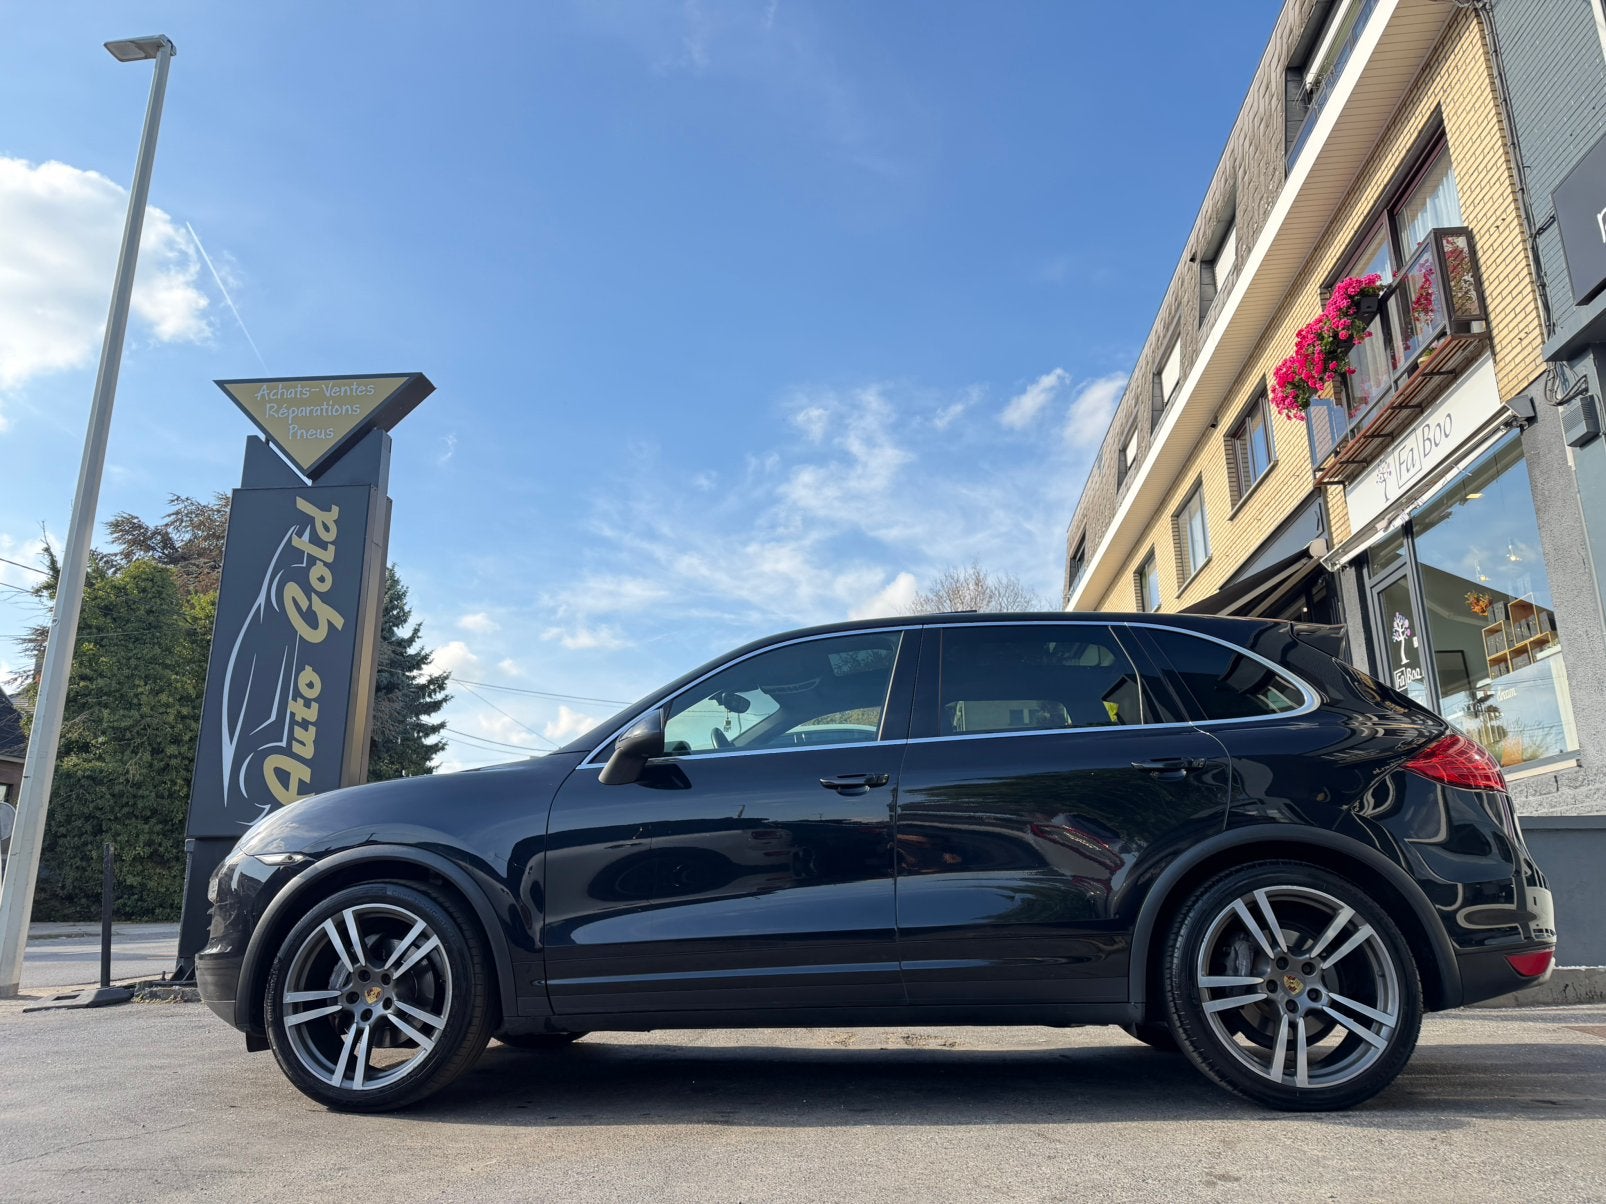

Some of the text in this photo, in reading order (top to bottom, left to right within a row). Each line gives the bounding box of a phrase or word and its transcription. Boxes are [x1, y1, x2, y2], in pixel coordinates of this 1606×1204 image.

[254, 381, 376, 400] Achats-Ventes
[265, 400, 361, 423] Réparations
[288, 424, 335, 441] Pneus
[263, 496, 345, 806] Auto Gold
